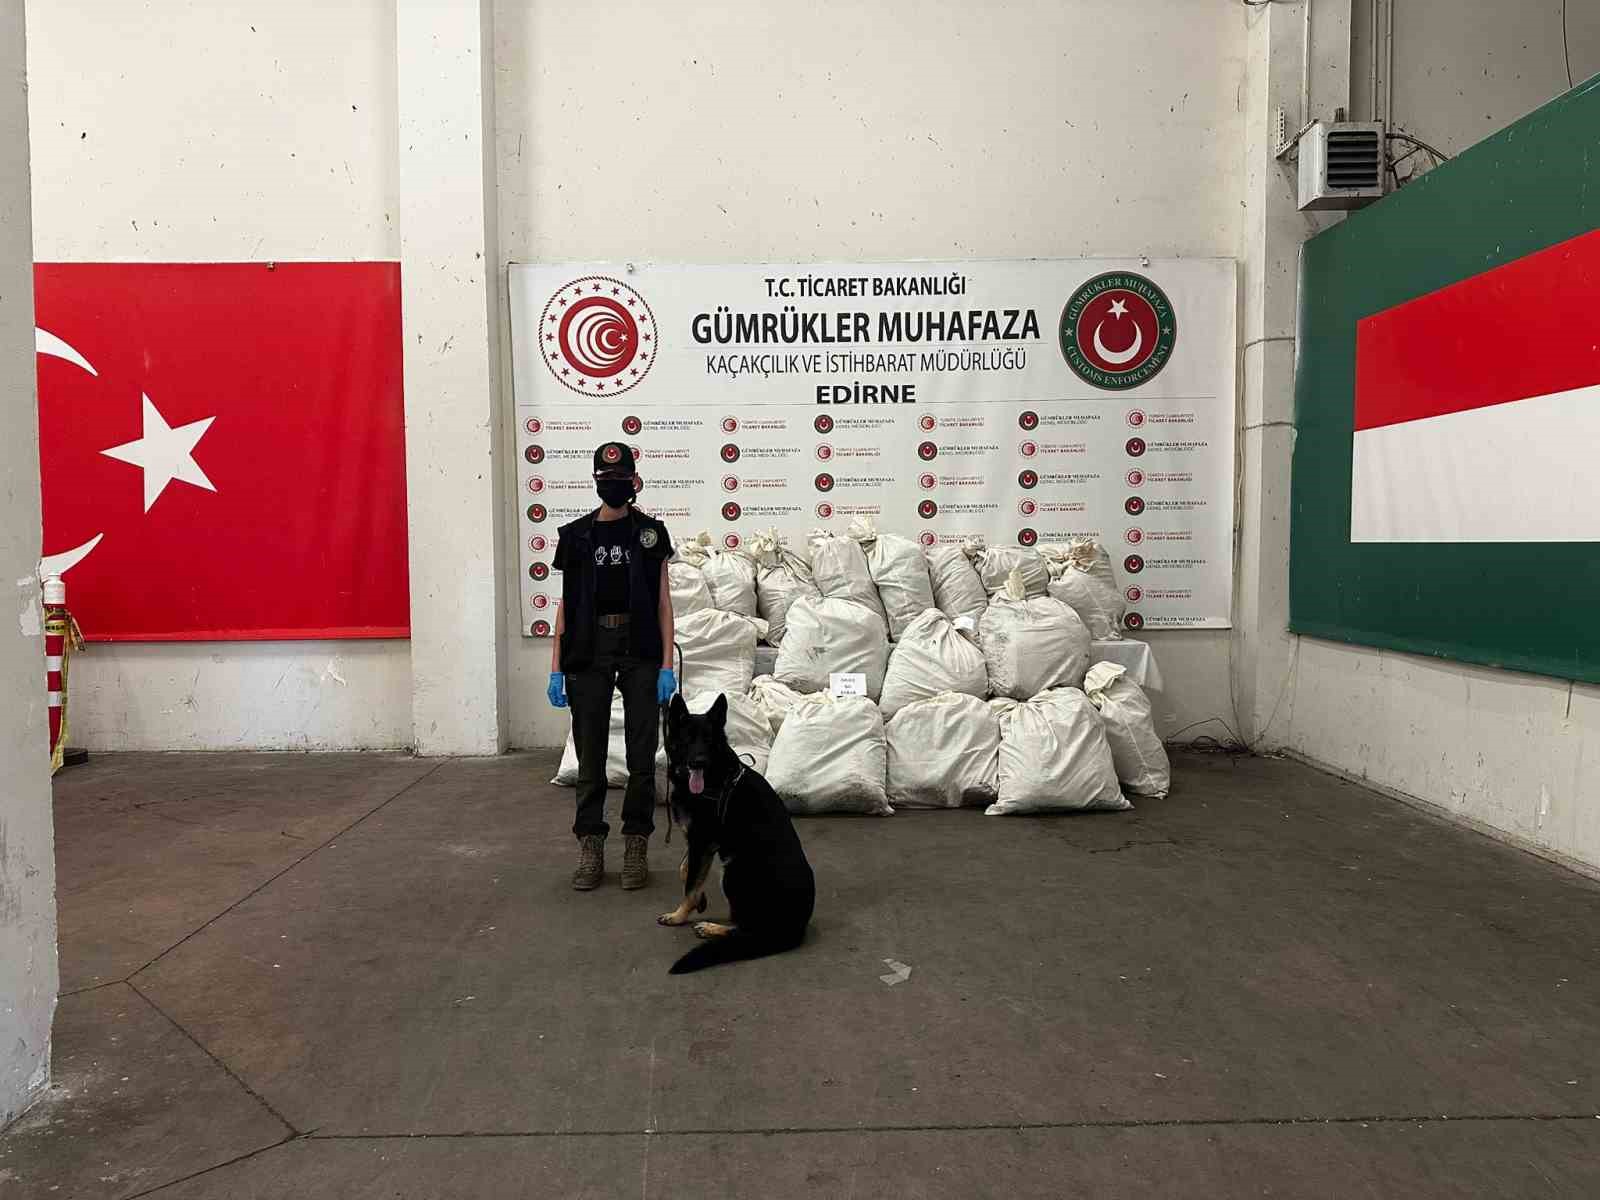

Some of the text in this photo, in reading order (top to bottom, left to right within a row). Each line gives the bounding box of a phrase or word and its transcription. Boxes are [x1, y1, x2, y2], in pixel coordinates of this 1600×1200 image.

[765, 272, 966, 297] T.C. TİCARET BAKANLIĞI
[692, 307, 1041, 344] GÜMRÜKLER MUHAFAZA
[707, 347, 1026, 379] KAÇAKÇILIK VE İSTİHBARAT MÜDÜRLÜĞÜ
[1067, 345, 1168, 385] CUSTOMS ENFORCEMENT
[816, 381, 916, 404] EDİRNE
